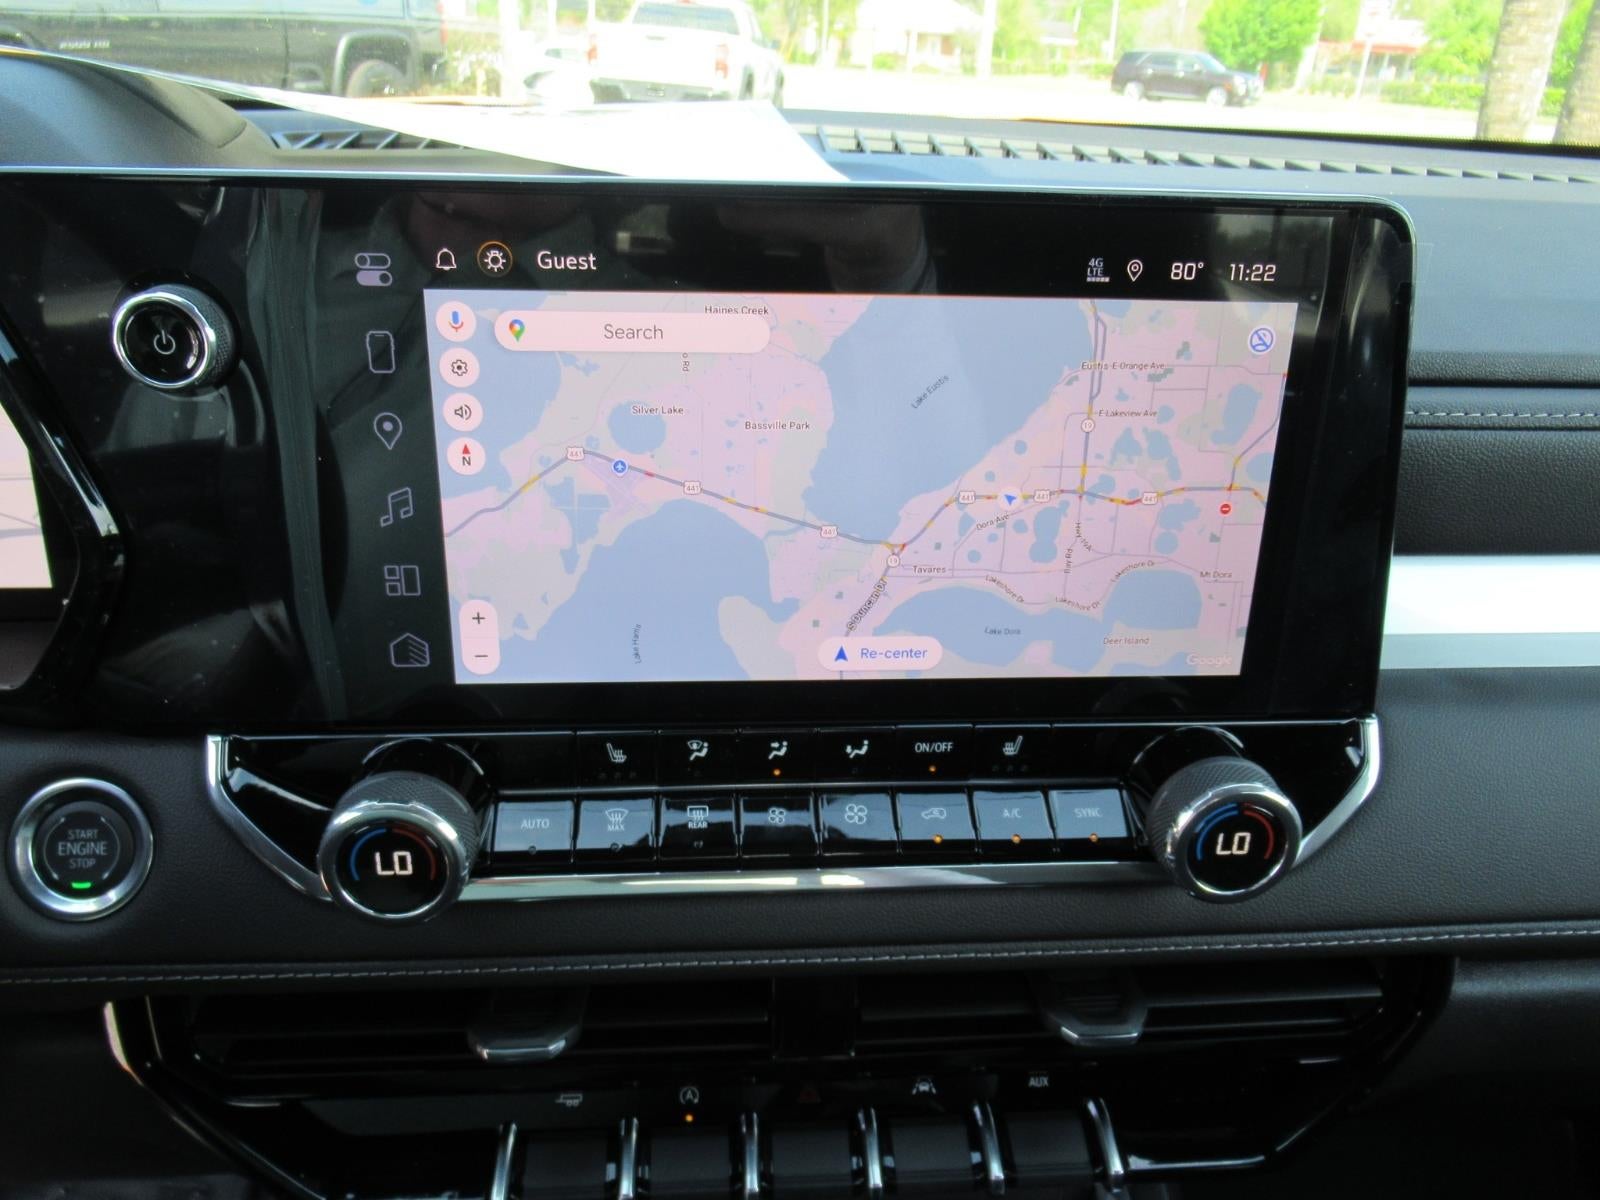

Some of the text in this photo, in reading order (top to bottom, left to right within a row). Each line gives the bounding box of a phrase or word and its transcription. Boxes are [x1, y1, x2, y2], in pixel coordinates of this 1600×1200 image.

[536, 250, 597, 270] Guest
[1088, 257, 1104, 267] 4G
[1087, 267, 1104, 277] LTE
[1170, 261, 1204, 281] 80°
[1229, 263, 1276, 282] 11:22
[704, 305, 769, 316] Haines Creek
[603, 324, 664, 340] Search
[682, 360, 690, 372] Rd
[1120, 361, 1149, 372] Orange
[1150, 361, 1165, 370] Ave
[911, 375, 950, 409] Lake Eustis
[632, 405, 684, 416] Silver Lake
[1098, 409, 1158, 417] E Lakeview Ave
[744, 421, 811, 431] Bassville Park
[462, 456, 472, 466] N
[685, 484, 700, 493] 441
[960, 493, 975, 502] 441
[1036, 493, 1050, 501] 441
[976, 514, 1010, 531] Dora Ave
[1064, 548, 1074, 560] Rd
[912, 564, 947, 574] Tavares
[1200, 570, 1233, 578] Mt Dora
[985, 575, 1025, 604] Lakeshore Dr
[1055, 596, 1091, 612] Lakeshore
[984, 626, 1021, 636] Lake Dora
[1103, 636, 1150, 645] Deer Island
[860, 647, 928, 660] Re-center
[1186, 653, 1233, 668] Google
[914, 741, 953, 754] ON/OFF
[1002, 807, 1022, 819] A/C
[1073, 807, 1102, 819] SYNC
[519, 817, 551, 830] AUTO
[607, 823, 626, 832] MAX
[687, 820, 709, 830] REAR
[67, 828, 99, 841] START
[57, 841, 108, 856] ENGINE
[1215, 832, 1252, 856] LO
[68, 858, 97, 869] STOP
[374, 850, 414, 876] LO
[1027, 1076, 1050, 1088] AUX
